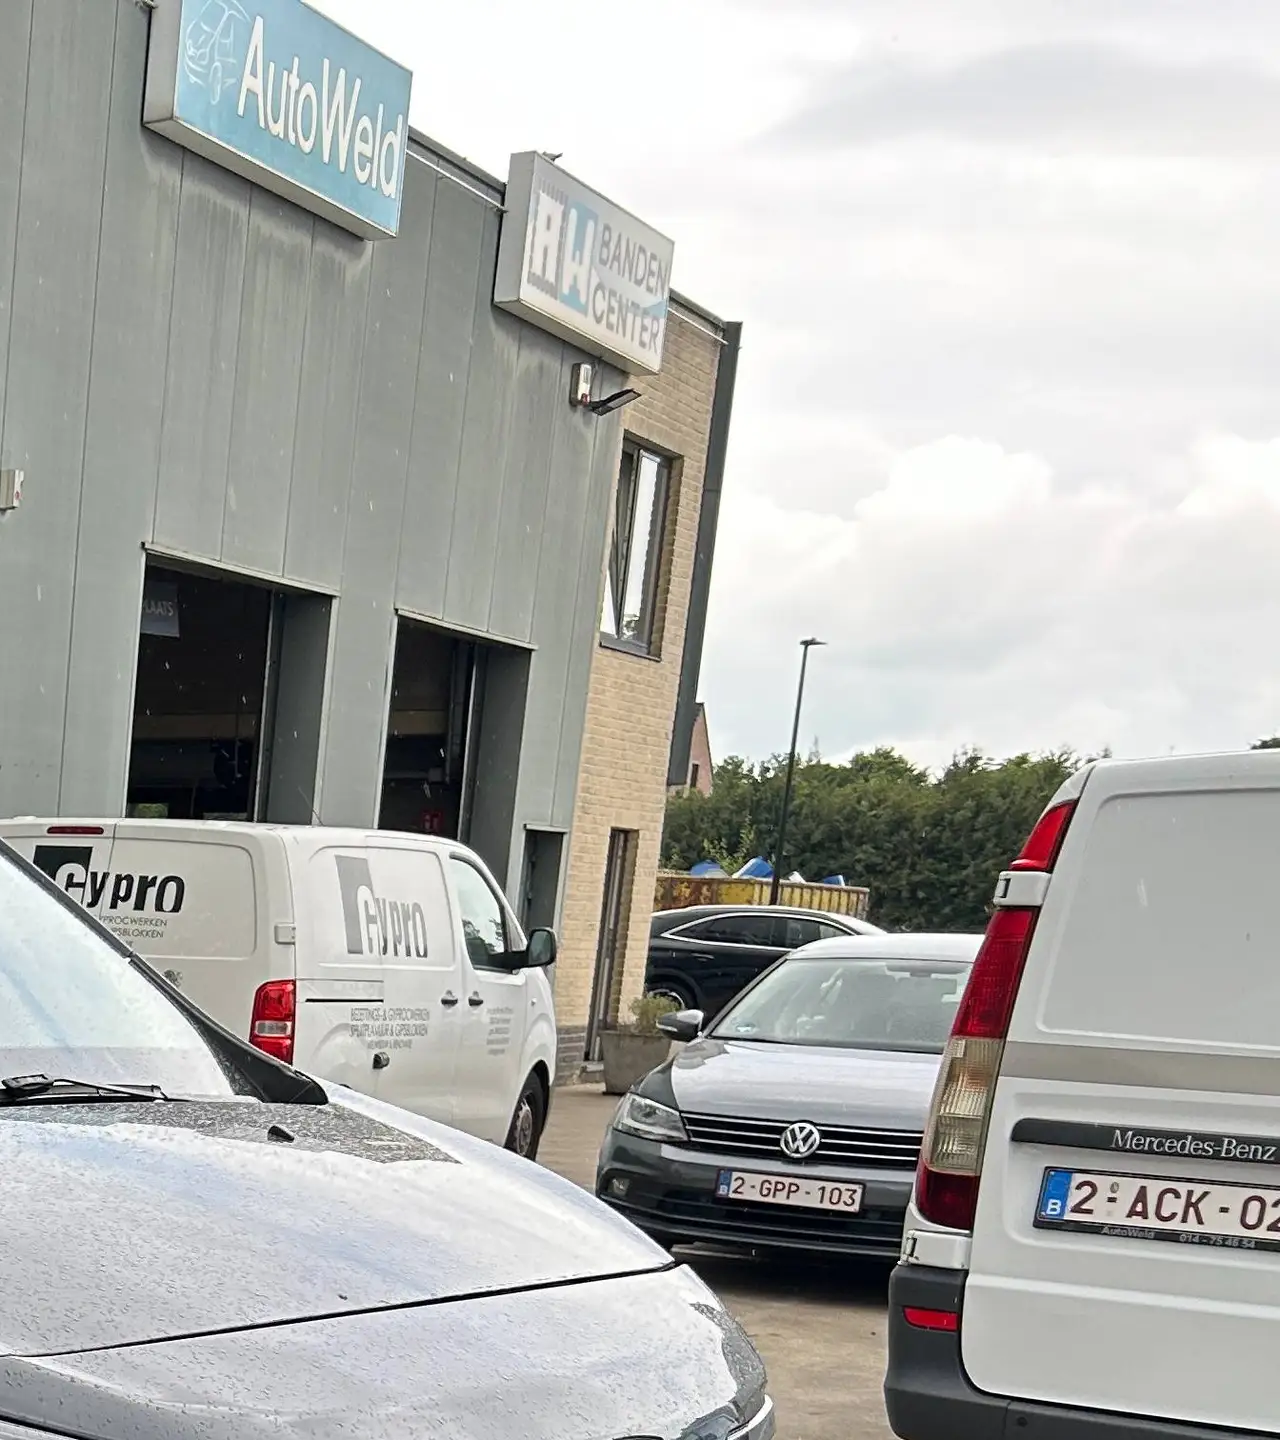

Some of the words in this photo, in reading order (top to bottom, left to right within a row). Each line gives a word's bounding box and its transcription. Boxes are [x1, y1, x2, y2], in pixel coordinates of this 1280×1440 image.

[237, 15, 403, 199] AutoWeld
[598, 222, 670, 300] BANDEN
[592, 281, 661, 355] CENTER
[54, 862, 186, 913] Gypro
[356, 884, 428, 959] Gypro
[1110, 1128, 1278, 1161] Mercedes-Benz
[732, 1176, 858, 1207] 2-GPP-103
[1045, 1198, 1063, 1216] B
[1100, 1225, 1156, 1240] AutoWeld
[1209, 1236, 1224, 1246] 75
